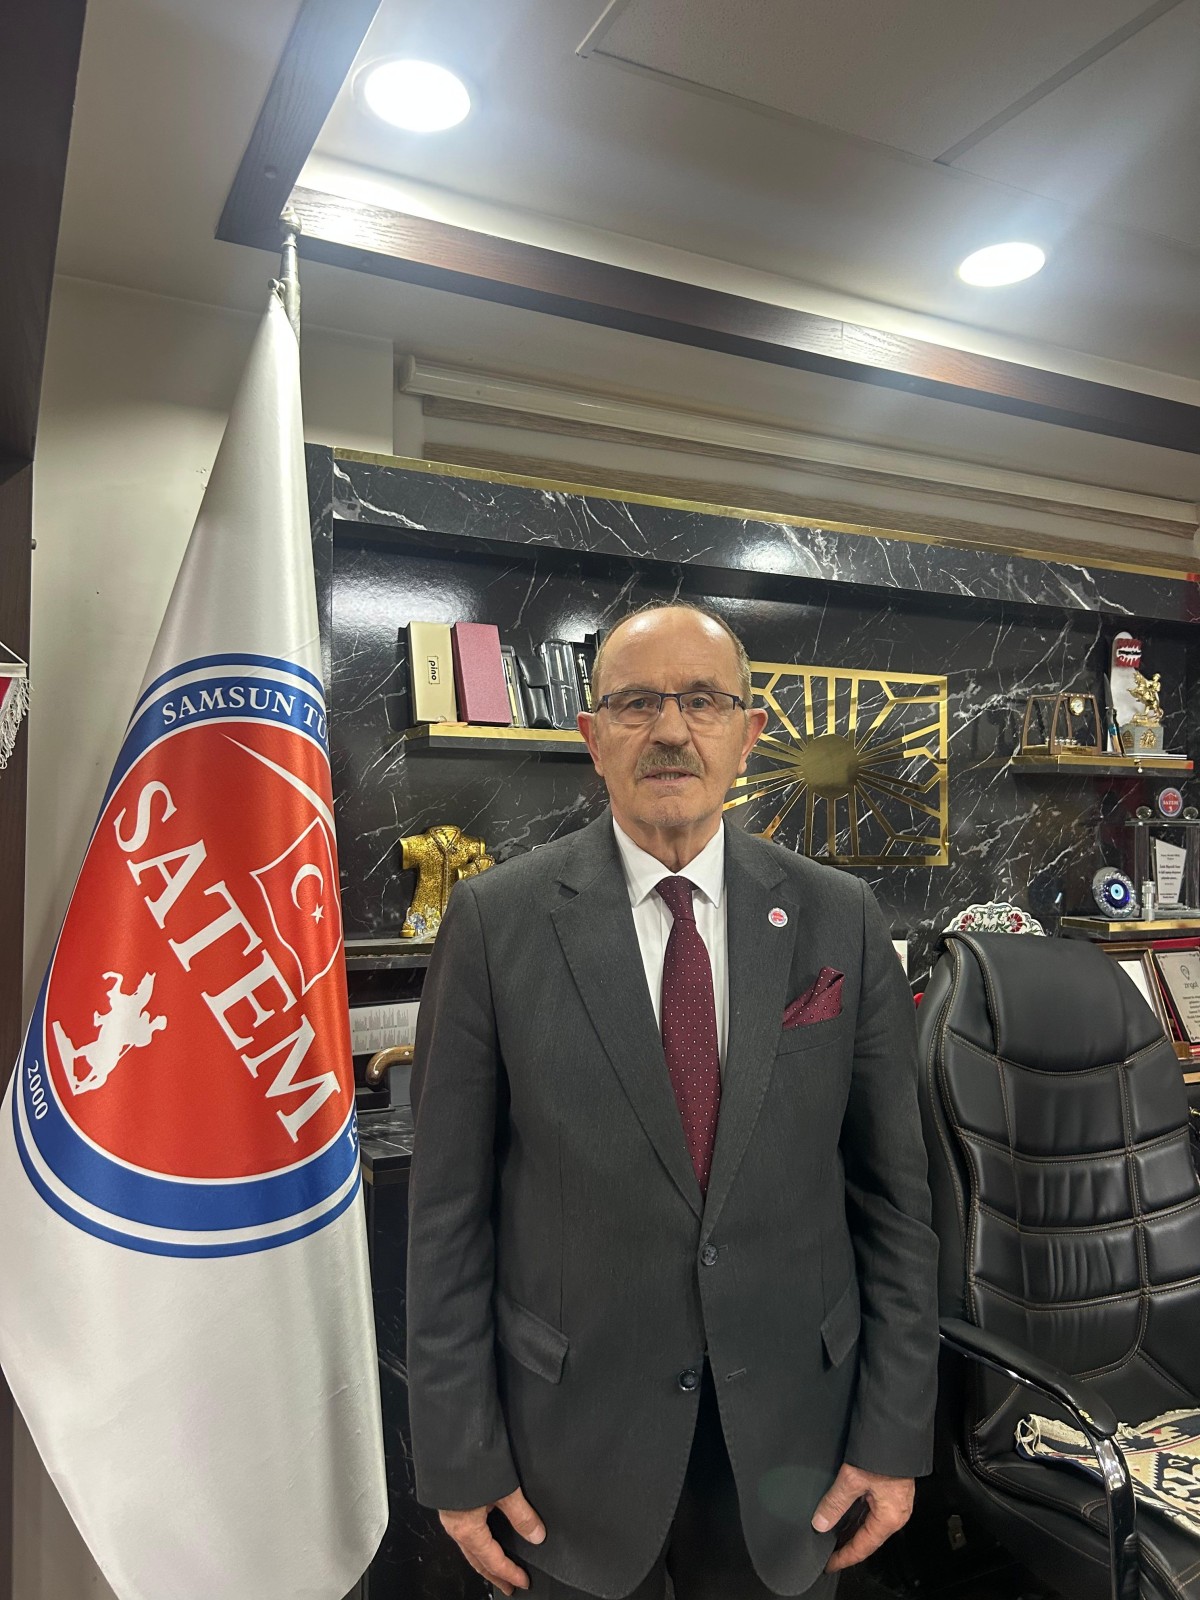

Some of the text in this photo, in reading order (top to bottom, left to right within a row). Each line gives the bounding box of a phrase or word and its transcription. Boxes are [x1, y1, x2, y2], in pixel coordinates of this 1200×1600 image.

[428, 660, 438, 681] pino
[161, 686, 329, 746] SAMSUN TÜ
[113, 780, 342, 1144] SATEM
[27, 1059, 49, 1120] 2000
